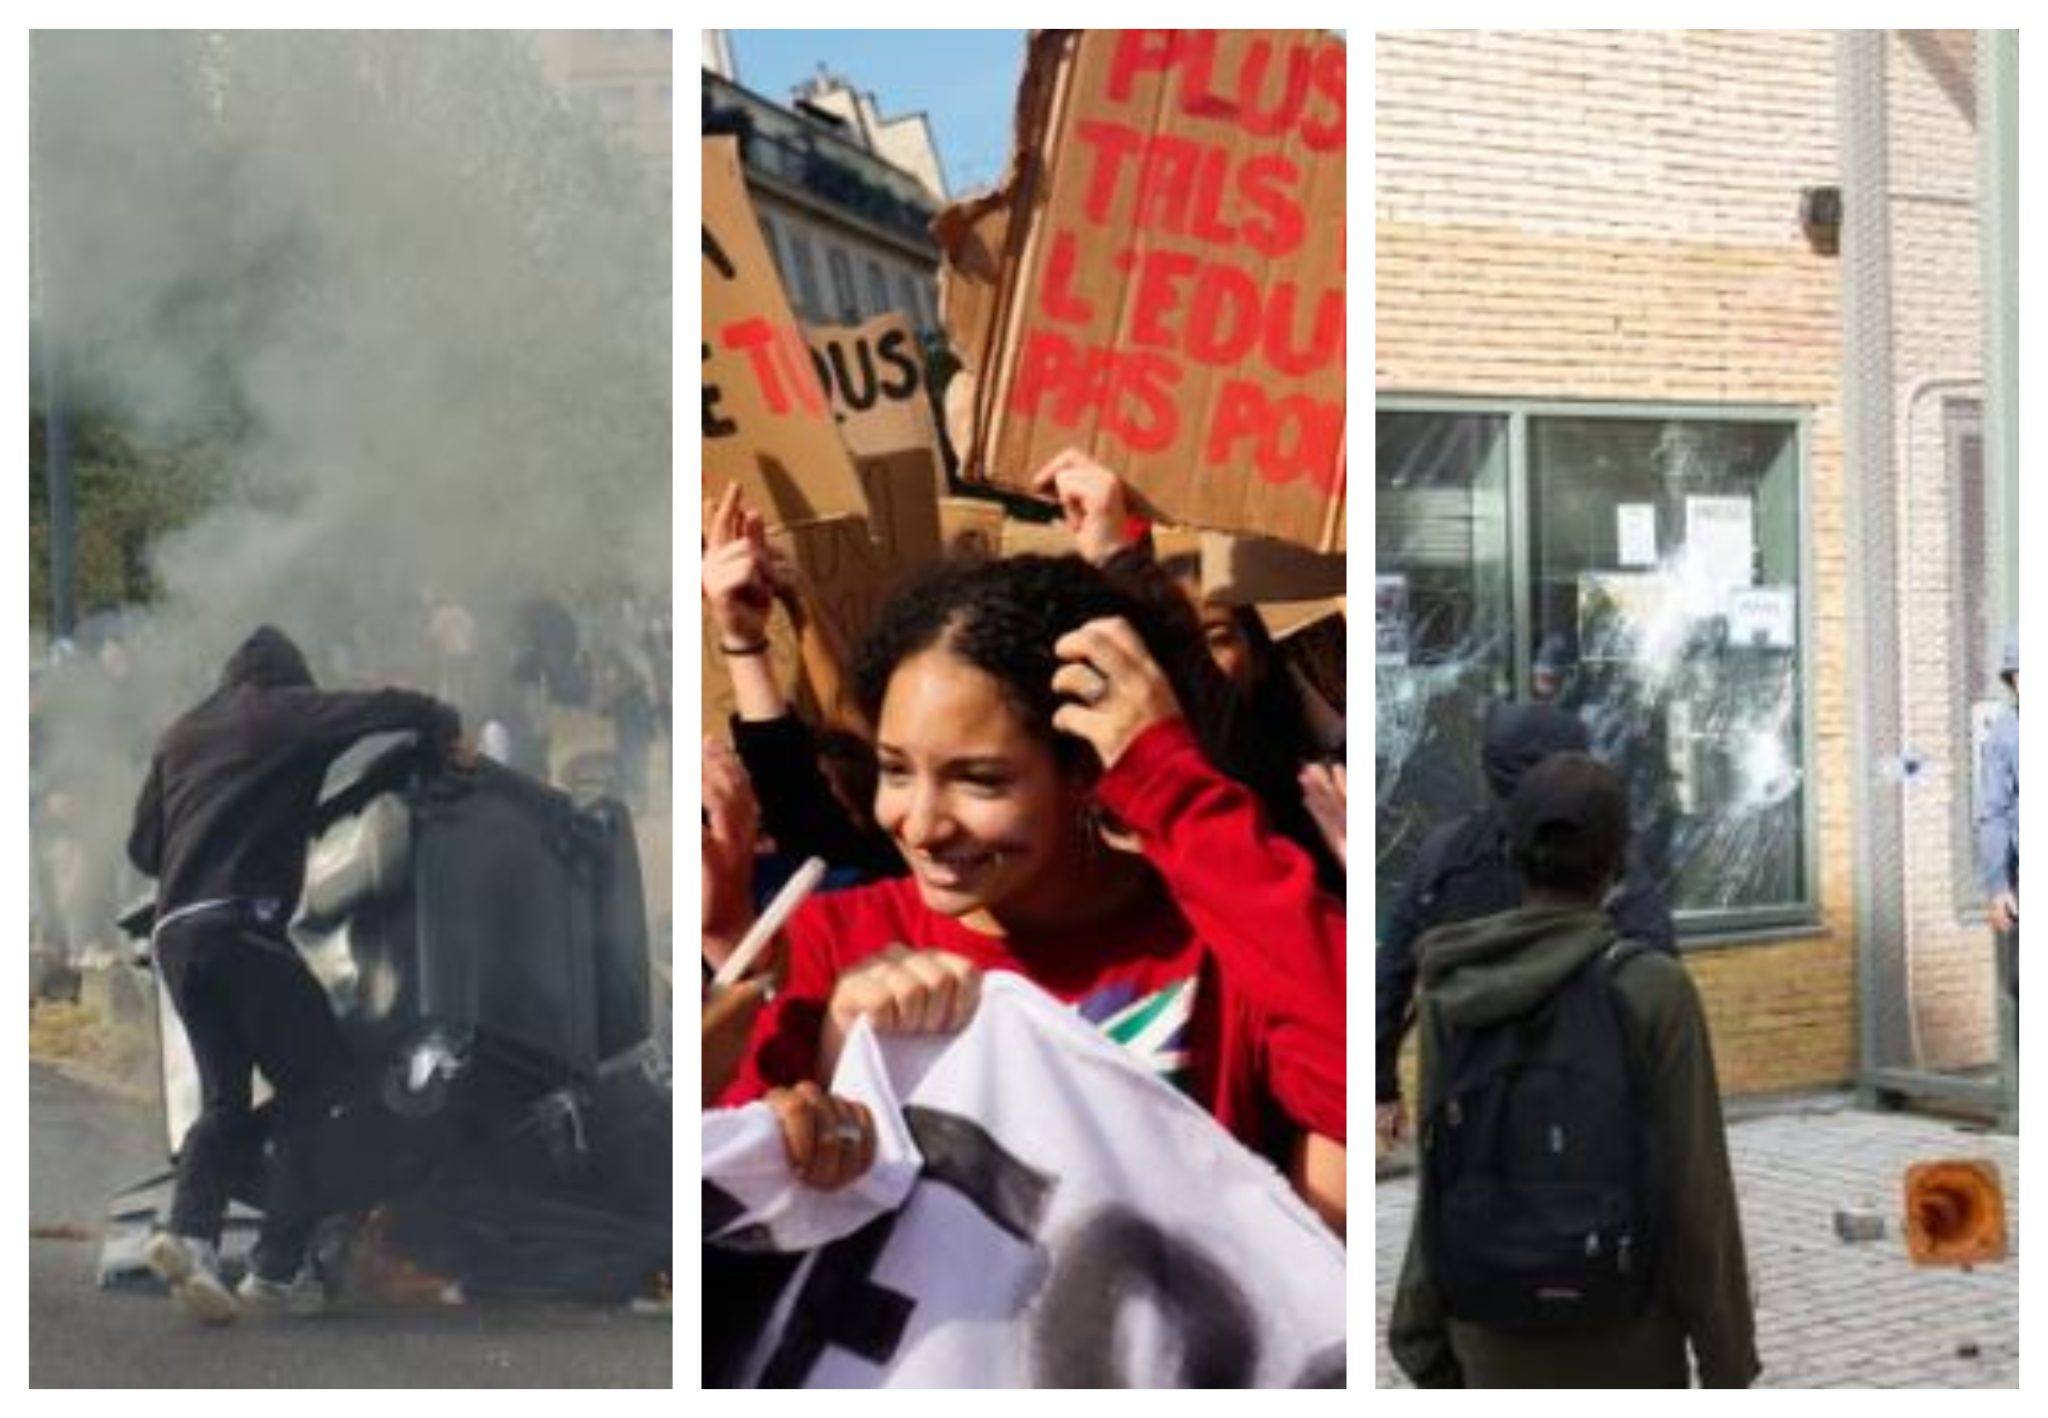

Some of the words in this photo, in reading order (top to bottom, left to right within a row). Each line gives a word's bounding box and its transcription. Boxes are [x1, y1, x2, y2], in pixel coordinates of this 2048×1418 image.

[1108, 29, 1346, 154] PLUS
[1076, 120, 1307, 259] TALS
[1011, 329, 1183, 453] PAS
